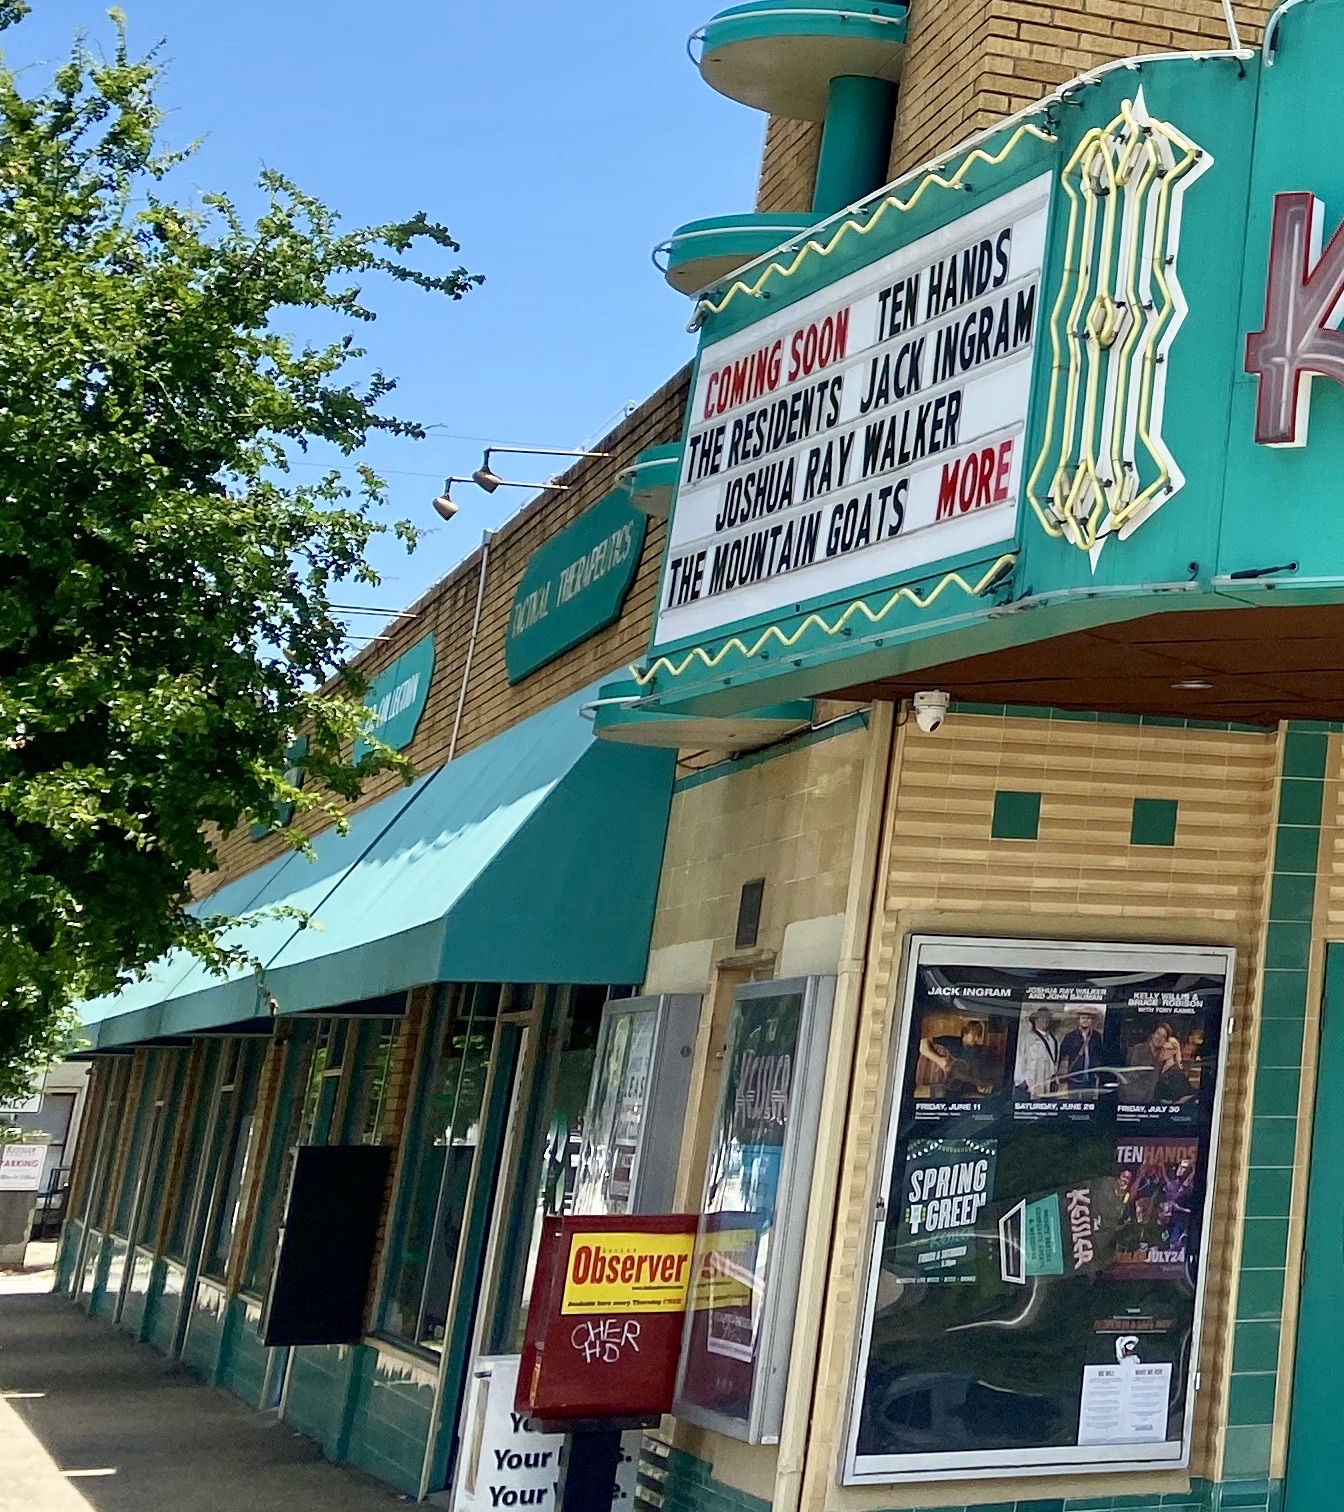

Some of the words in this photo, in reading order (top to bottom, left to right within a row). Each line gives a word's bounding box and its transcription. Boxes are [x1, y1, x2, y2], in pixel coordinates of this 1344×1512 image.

[702, 343, 782, 419] COMING
[787, 305, 851, 377] SOON
[877, 271, 923, 342] TEN
[926, 227, 1012, 326] HANDS
[687, 418, 725, 484] THE
[727, 374, 844, 469] RESIDENTS
[859, 335, 926, 415] JACK
[930, 284, 1038, 380] INGRAM
[714, 457, 796, 532] JOSHUA
[805, 430, 856, 495] RAY
[861, 389, 964, 478] WALKER
[667, 552, 705, 608] THE
[708, 510, 823, 595] MOUNTAIN
[825, 478, 910, 558] GOATS
[936, 439, 1014, 522] MORE
[927, 986, 961, 997] JACK
[962, 987, 1012, 998] INGRAM
[1075, 987, 1106, 995] WALKER
[1133, 992, 1160, 1000] KELLY
[947, 1103, 971, 1112] JUNE
[972, 1103, 981, 1111] 11
[1060, 1103, 1082, 1112] JUNE
[1148, 1105, 1167, 1113] JULY
[1168, 1105, 1180, 1113] 30
[1116, 1145, 1144, 1164] TEN
[908, 1159, 988, 1203] SPRING
[925, 1192, 987, 1232] GREEN
[1066, 1188, 1095, 1271] KESSLER
[571, 1244, 689, 1286] Observer
[493, 1448, 553, 1471] Your
[489, 1484, 549, 1508] Your
